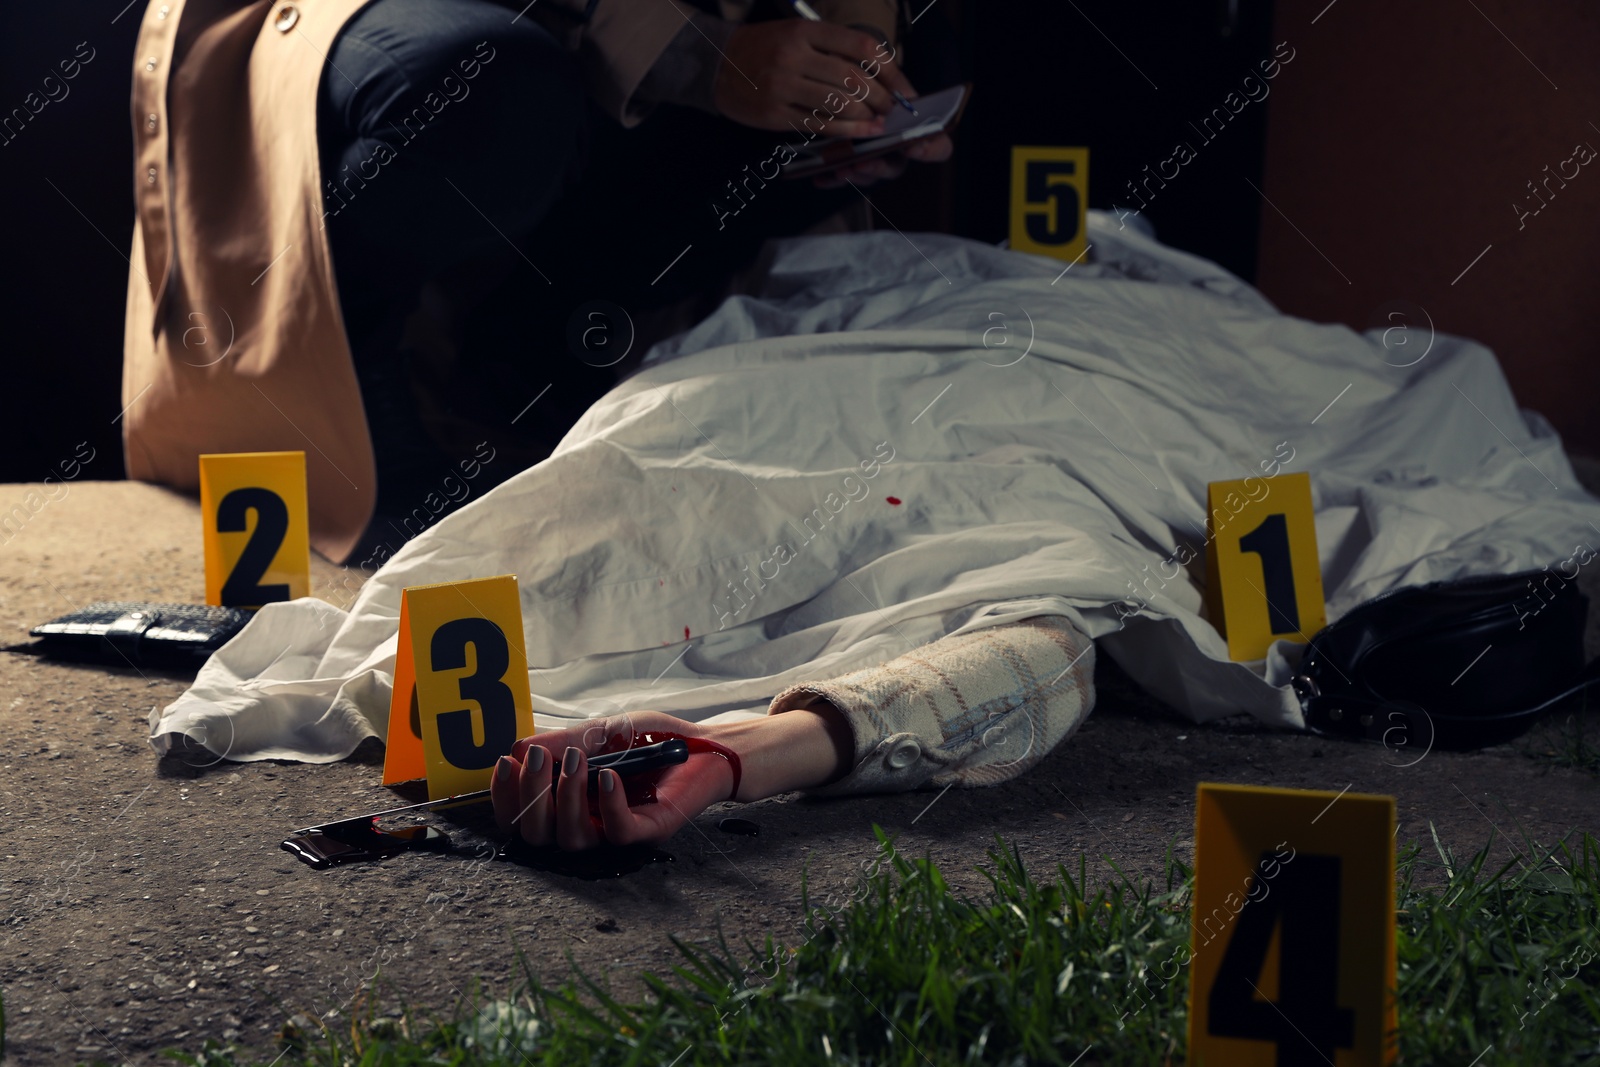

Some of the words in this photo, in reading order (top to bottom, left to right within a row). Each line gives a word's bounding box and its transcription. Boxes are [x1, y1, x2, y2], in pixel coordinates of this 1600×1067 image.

[1027, 162, 1078, 244] 5
[217, 487, 290, 607] 2
[1239, 514, 1300, 634] 1
[431, 618, 516, 770] 3
[1209, 852, 1354, 1067] 4
